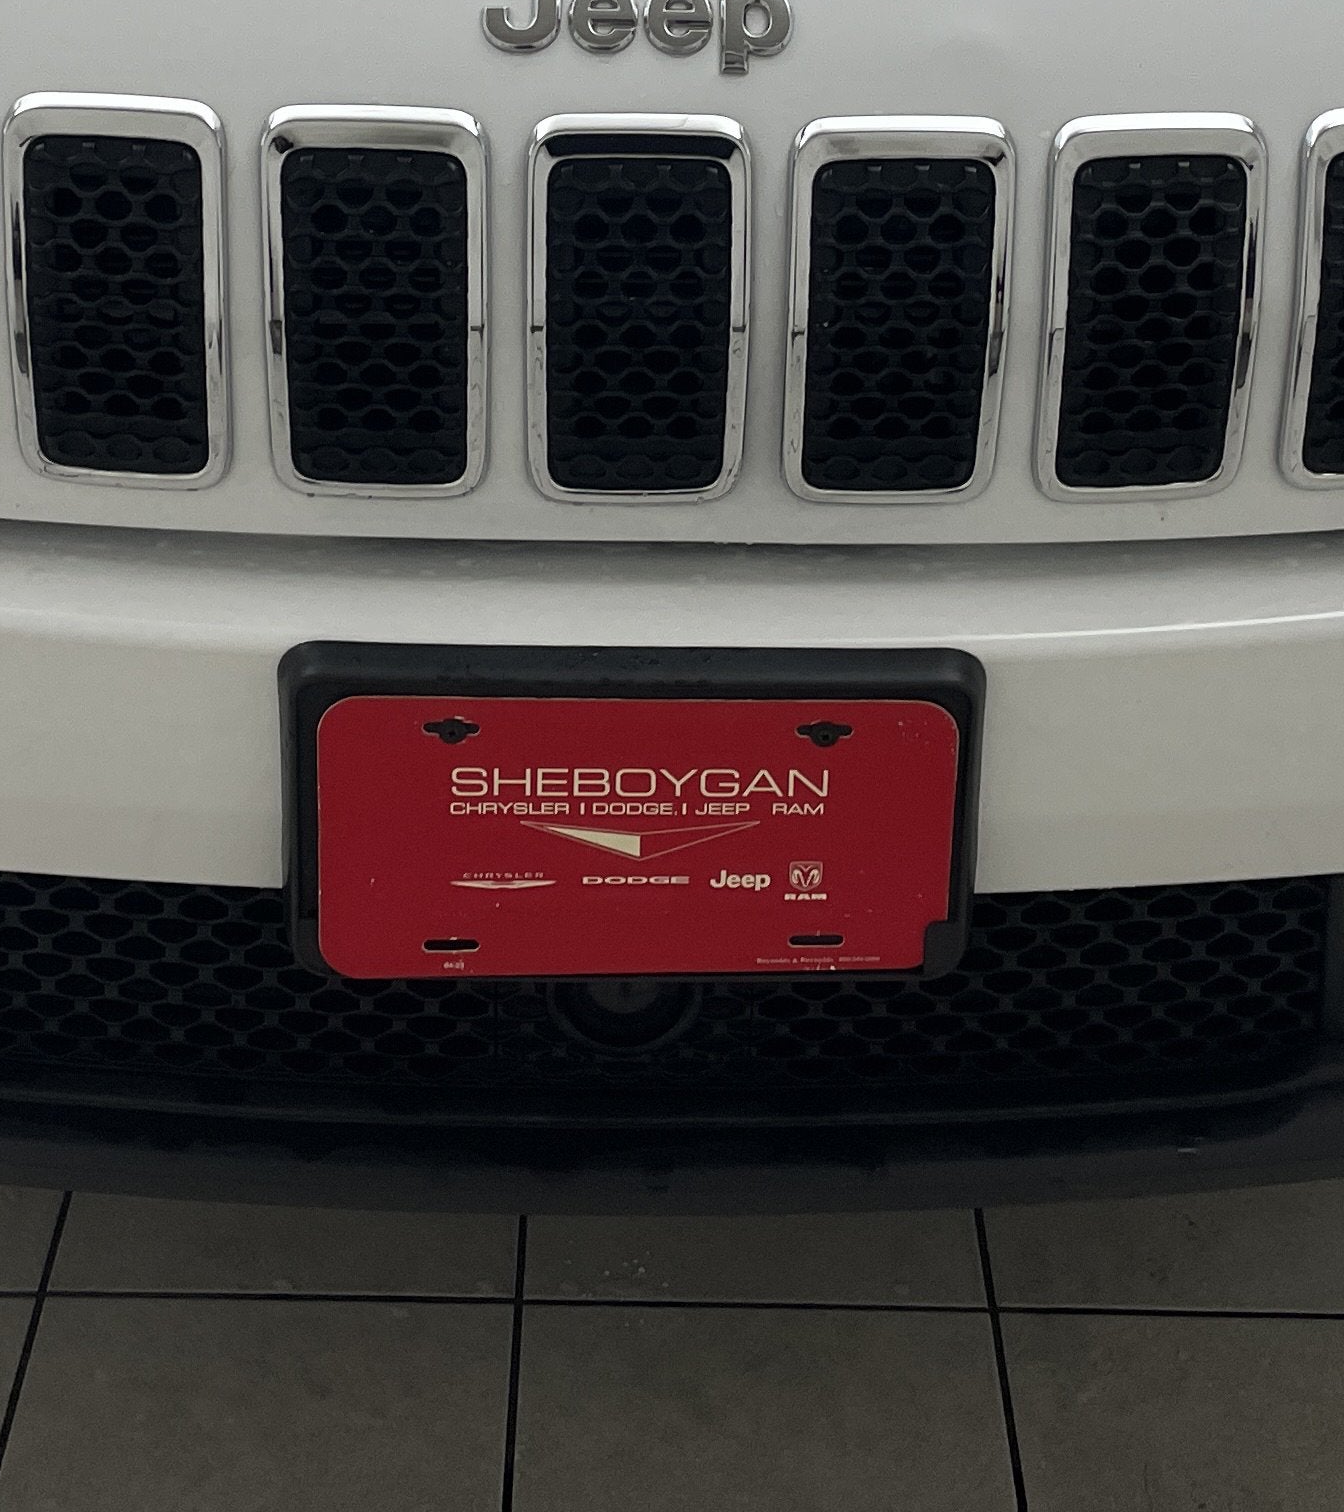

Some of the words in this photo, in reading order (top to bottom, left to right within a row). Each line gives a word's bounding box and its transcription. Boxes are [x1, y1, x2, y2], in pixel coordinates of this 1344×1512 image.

[450, 766, 830, 798] SHEBOYGAN
[450, 801, 570, 815] CHRYSLER
[695, 802, 751, 815] JEEP
[772, 802, 824, 816] RAM
[582, 876, 690, 885] DODGE
[709, 869, 771, 891] Jeep
[784, 893, 827, 901] RAM
